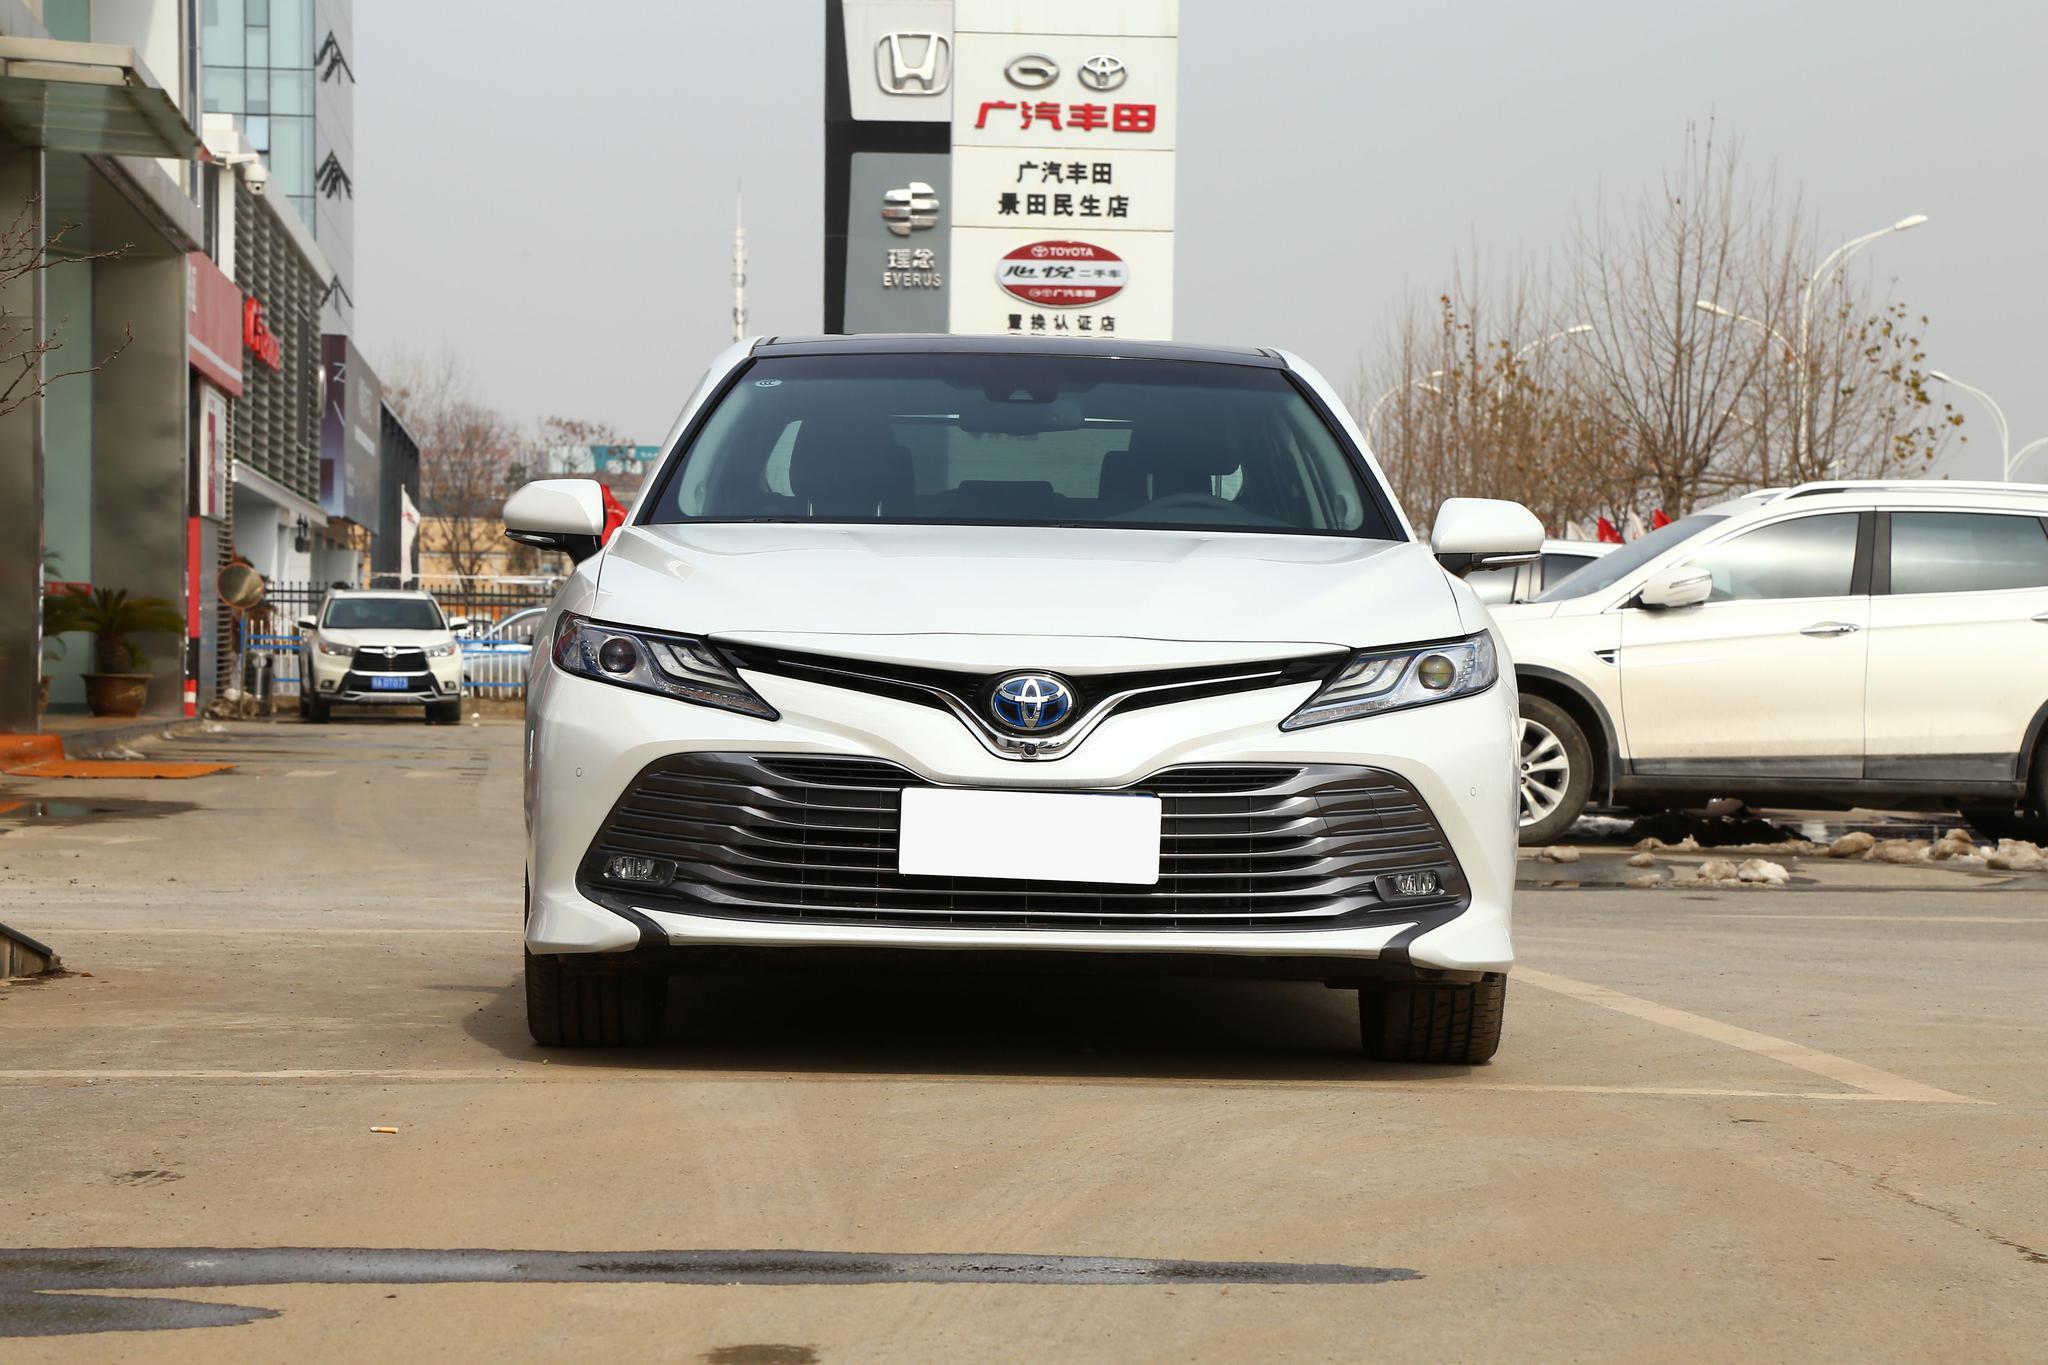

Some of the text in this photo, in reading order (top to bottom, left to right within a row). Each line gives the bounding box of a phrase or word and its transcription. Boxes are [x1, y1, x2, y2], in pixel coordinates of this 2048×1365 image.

[975, 101, 1156, 132] 广汽丰田
[1017, 161, 1112, 184] 广汽丰田
[998, 193, 1129, 217] 景田民生店
[887, 248, 936, 269] 理念
[1049, 247, 1094, 257] TOYOTA
[883, 271, 942, 287] EVERUS
[1008, 313, 1116, 332] 置换认证店
